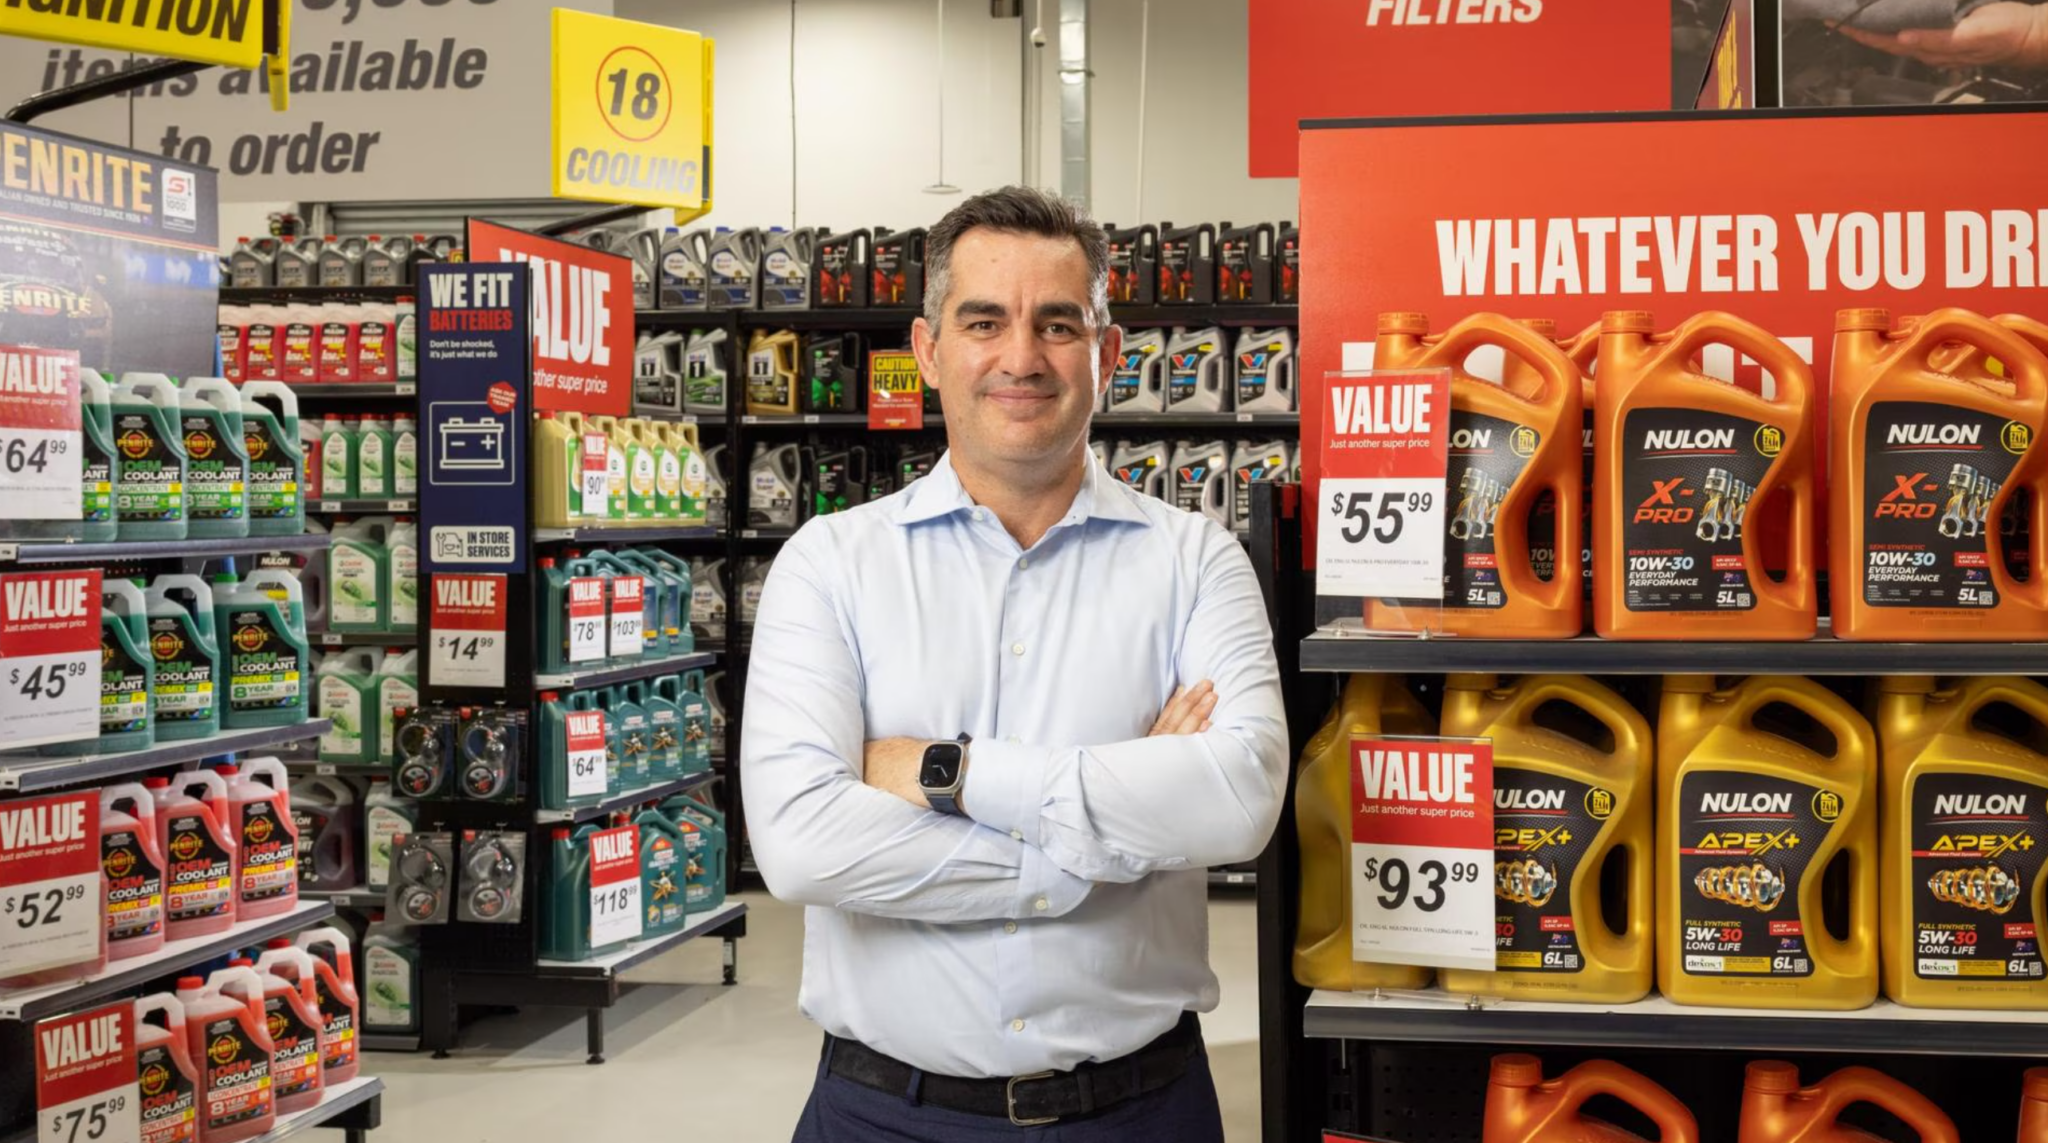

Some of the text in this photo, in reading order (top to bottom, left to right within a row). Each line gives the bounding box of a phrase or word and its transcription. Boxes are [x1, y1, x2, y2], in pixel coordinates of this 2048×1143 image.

[608, 68, 660, 120] 18
[161, 121, 381, 175] to order
[566, 147, 698, 194] COOLING
[1435, 214, 1778, 296] WHATEVER
[1795, 212, 1925, 291] YOU
[429, 273, 513, 307] WE FIT
[500, 248, 611, 366] ALUE
[429, 310, 513, 331] BATTERIES
[451, 340, 460, 348] be
[456, 350, 475, 359] what
[558, 374, 607, 395] super price
[874, 373, 918, 390] HEAVY
[1331, 384, 1432, 434] VALUE
[1643, 429, 1735, 450] NULON
[1886, 424, 1981, 444] NULON
[117, 439, 153, 447] PENRITE
[1330, 439, 1430, 450] Just another super price
[0, 438, 48, 473] 64
[124, 471, 180, 480] COOLANT
[188, 471, 241, 480] COOLANT
[1633, 508, 1694, 524] PRO
[1874, 503, 1938, 519] PRO
[467, 531, 510, 544] IN STORE
[467, 546, 510, 557] SERVICES
[1869, 552, 1936, 566] 10W-30
[1629, 557, 1694, 571] 10W-30
[1868, 566, 1918, 574] EVERYDAY
[1629, 571, 1677, 579] EVERYDAY
[1629, 578, 1699, 587] PERFORMANCE
[1868, 574, 1940, 582] PERFORMANCE
[5, 578, 88, 621] VALUE
[436, 579, 496, 607] VALUE
[1467, 589, 1487, 601] 5L
[1716, 591, 1736, 603] 5L
[1957, 588, 1978, 601] 5L
[232, 632, 268, 642] PENRITE
[240, 661, 296, 672] COOLANT
[232, 674, 271, 684] PREMIX
[568, 715, 601, 736] VALUE
[1359, 750, 1474, 803] VALUE
[1700, 793, 1792, 812] NULON
[1934, 795, 2027, 815] NULON
[1360, 803, 1475, 819] Just another super price
[1, 801, 86, 849] VALUE
[244, 823, 274, 835] PENRITE
[170, 839, 203, 852] PENRITE
[592, 830, 633, 863] VALUE
[1697, 829, 1800, 853] APEX+
[1931, 831, 2035, 855] APEX+
[250, 848, 293, 863] COOLANT
[176, 866, 228, 881] COOLANT
[243, 863, 276, 875] PREMIX
[109, 883, 160, 899] COOLANT
[169, 882, 207, 895] PREMIX
[1685, 927, 1743, 942] 5W-30
[1919, 931, 1977, 944] 5W-30
[1686, 942, 1741, 951] LONG LIFE
[1919, 945, 1976, 954] LONG LIFE
[1544, 952, 1563, 965] 6L
[1773, 957, 1793, 969] 6L
[2008, 960, 2028, 972] 6L
[42, 1013, 122, 1070] VALUE
[208, 1041, 241, 1057] PENRITE
[216, 1059, 251, 1077] OEM
[216, 1066, 268, 1086] COOLANT
[143, 1096, 192, 1118] COOLANT
[210, 1101, 225, 1116] 8
